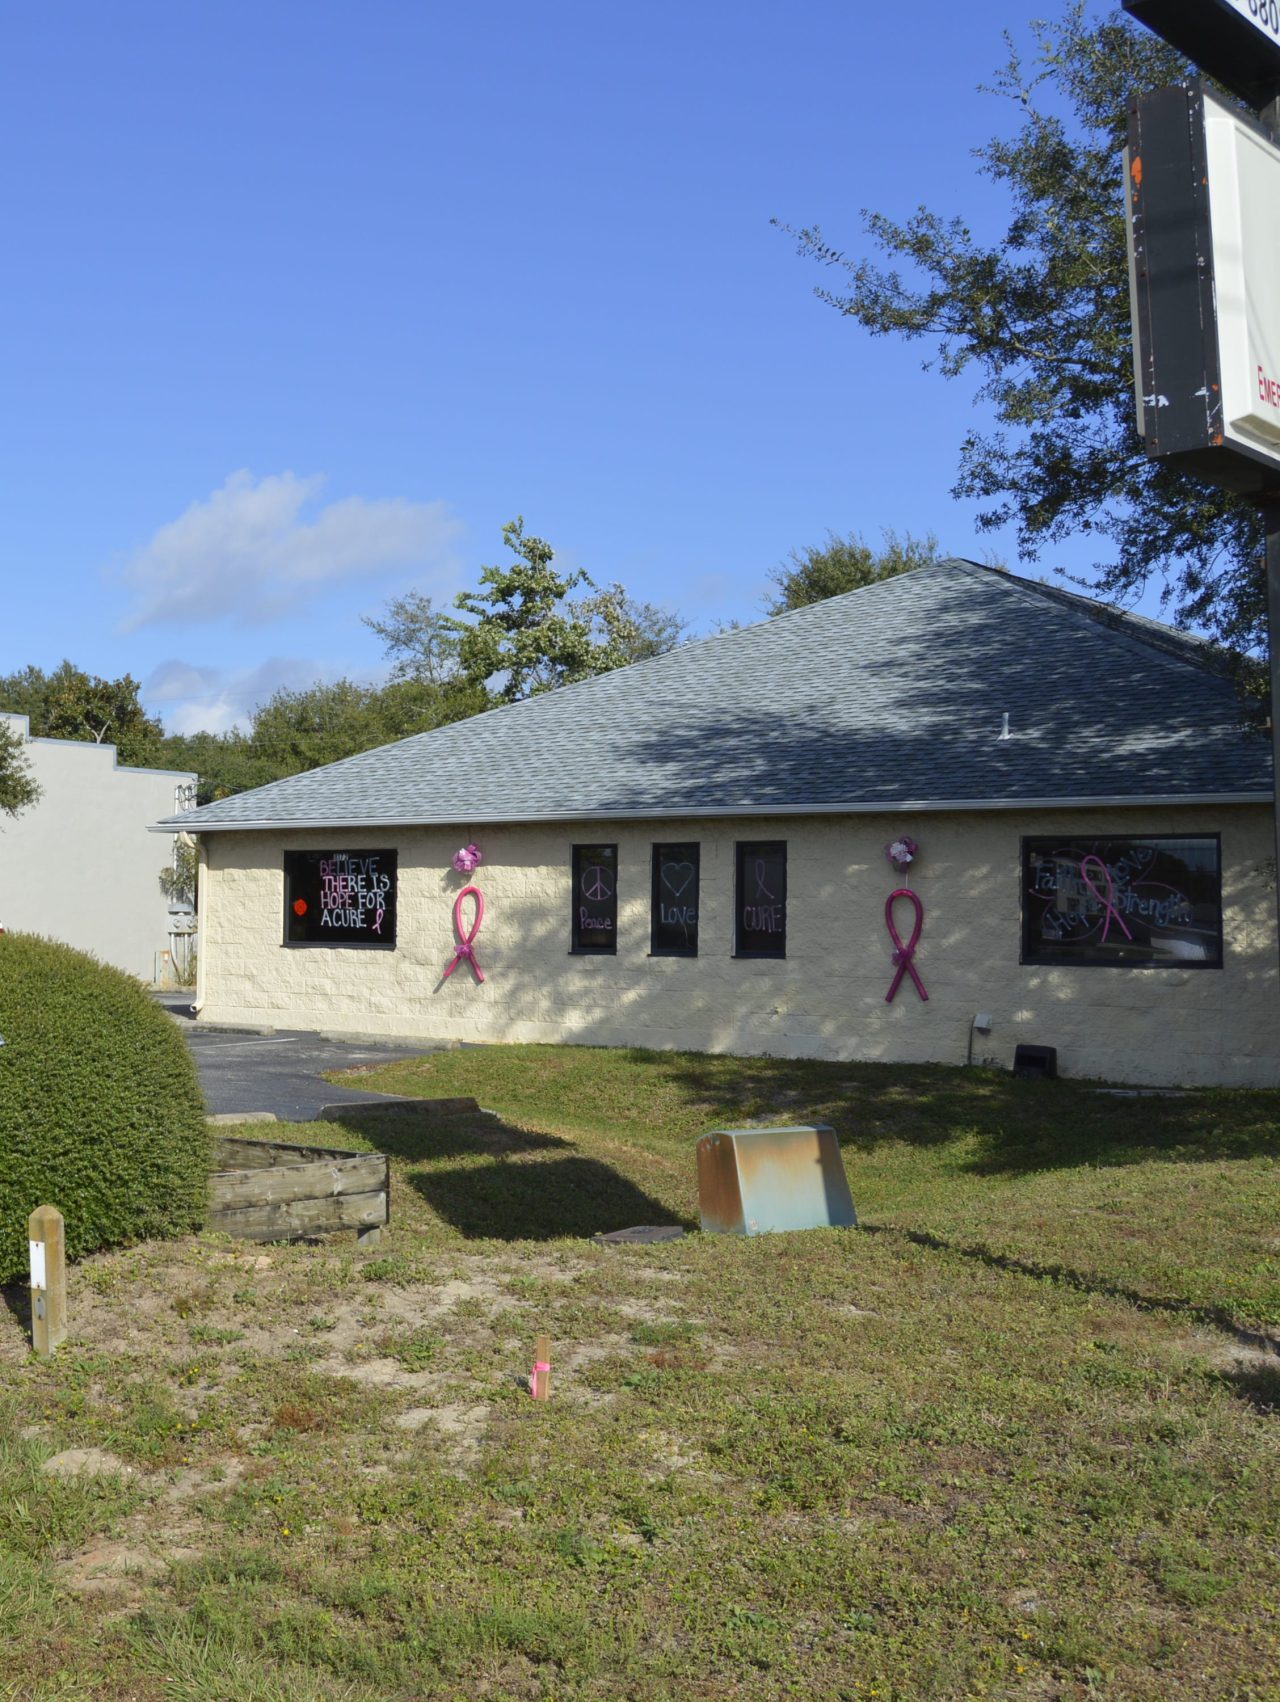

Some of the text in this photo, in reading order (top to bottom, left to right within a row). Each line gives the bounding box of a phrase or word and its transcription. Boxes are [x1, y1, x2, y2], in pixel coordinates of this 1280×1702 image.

[320, 856, 380, 876] BELIEVE
[1106, 846, 1153, 886] Love
[322, 874, 390, 892] THERE IS
[320, 891, 385, 910] HOPE FOR
[321, 909, 367, 928] A CURE
[579, 906, 613, 930] Peace
[660, 903, 696, 925] Love
[743, 904, 783, 933] CURE
